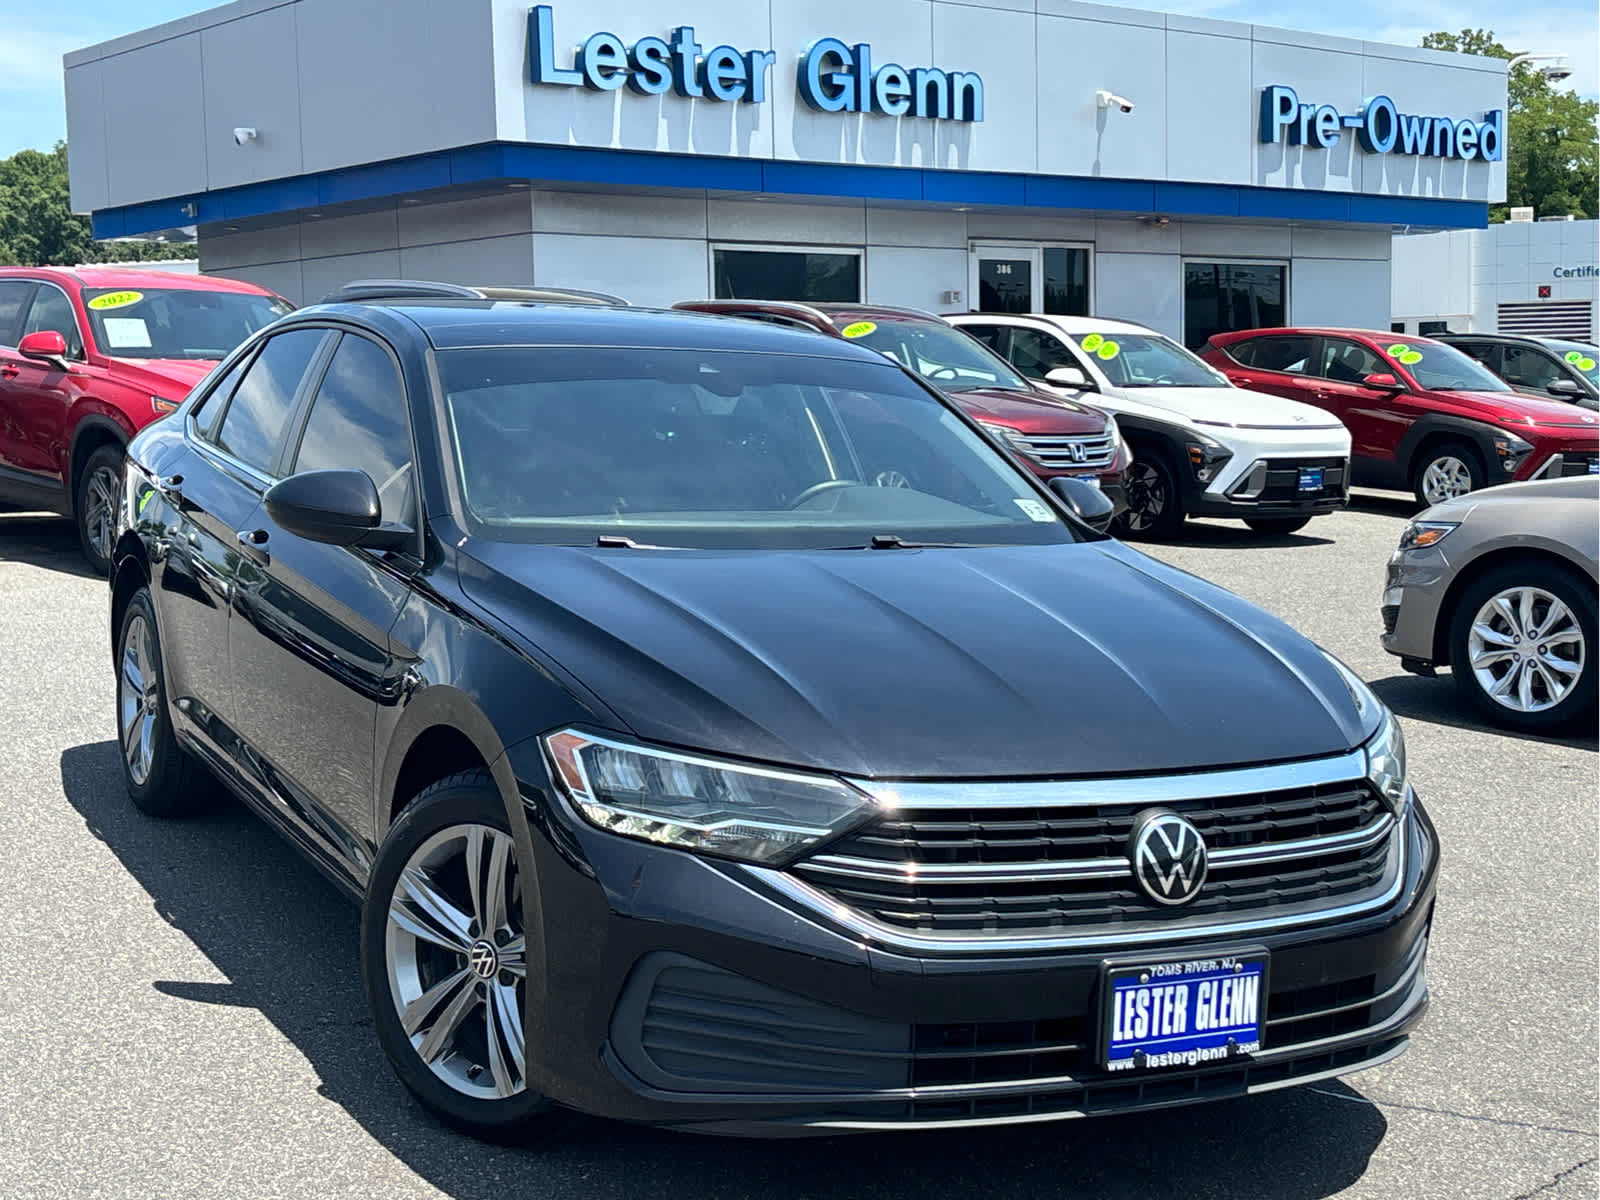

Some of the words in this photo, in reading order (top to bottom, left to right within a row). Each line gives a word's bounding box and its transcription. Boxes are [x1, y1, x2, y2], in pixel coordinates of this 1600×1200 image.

[527, 4, 776, 104] Lester
[797, 37, 985, 123] Glenn
[1260, 85, 1503, 162] Pre-Owned
[1150, 963, 1182, 978] TOMS
[1222, 957, 1236, 970] NJ
[1112, 984, 1189, 1042] LESTER
[1195, 975, 1259, 1031] GLENN
[1145, 1046, 1228, 1069] lesterglenn
[1236, 1040, 1260, 1054] .com
